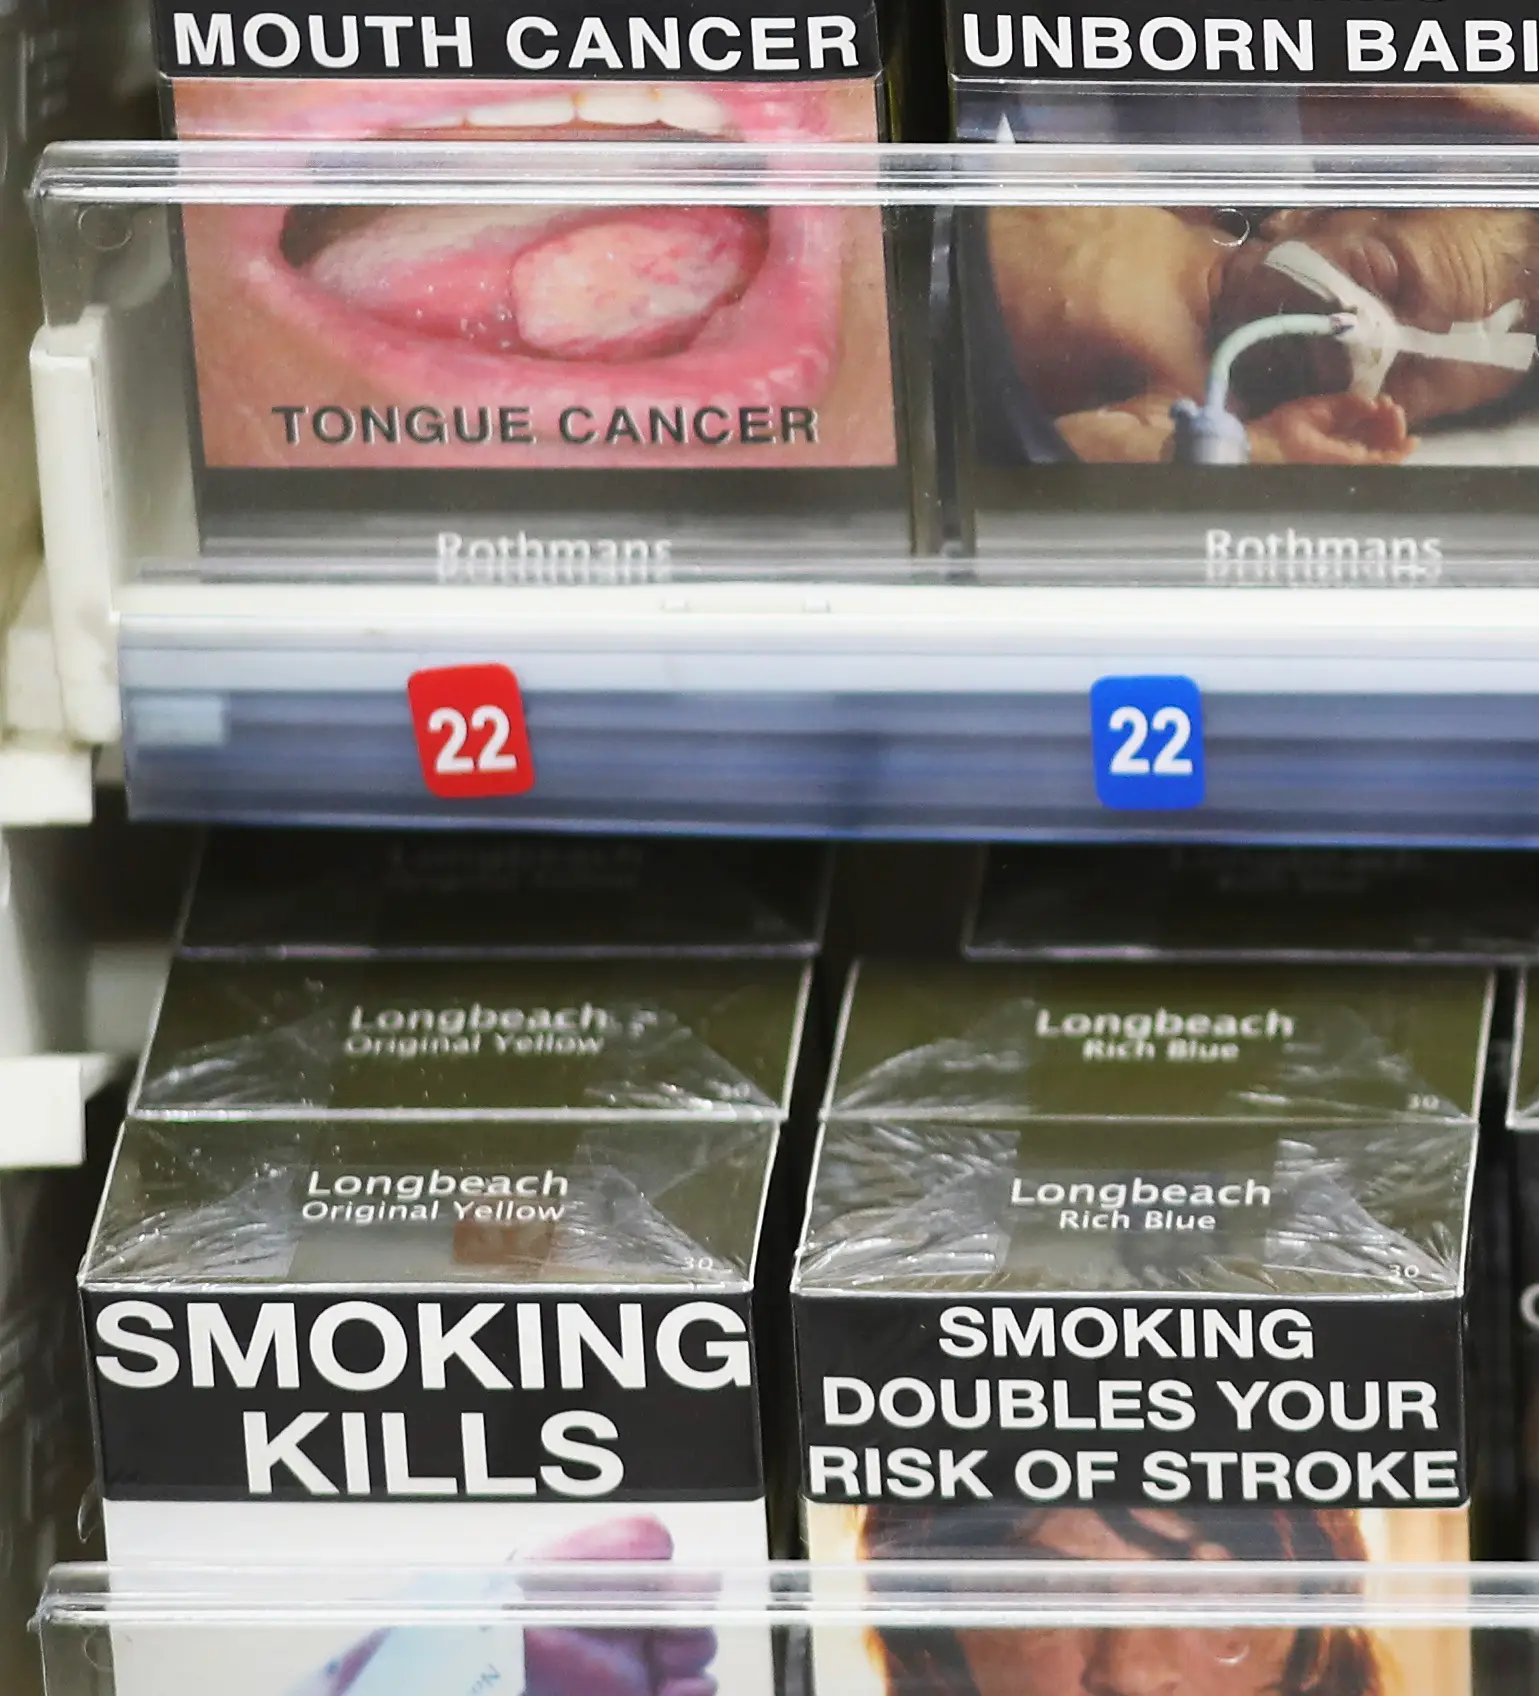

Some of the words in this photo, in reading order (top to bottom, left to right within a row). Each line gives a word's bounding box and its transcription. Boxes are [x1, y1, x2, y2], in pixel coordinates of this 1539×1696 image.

[174, 13, 472, 68] MOUTH
[507, 16, 858, 70] CANCER
[271, 405, 532, 445] TONGUE
[558, 405, 821, 445] CANCER
[429, 706, 516, 772] 22
[1110, 707, 1192, 774] 22
[303, 1201, 438, 1224] Original
[454, 1201, 566, 1221] Yellow
[309, 1169, 568, 1200] Longbeach
[96, 1301, 751, 1390] SMOKING
[244, 1411, 623, 1496] KILLS
